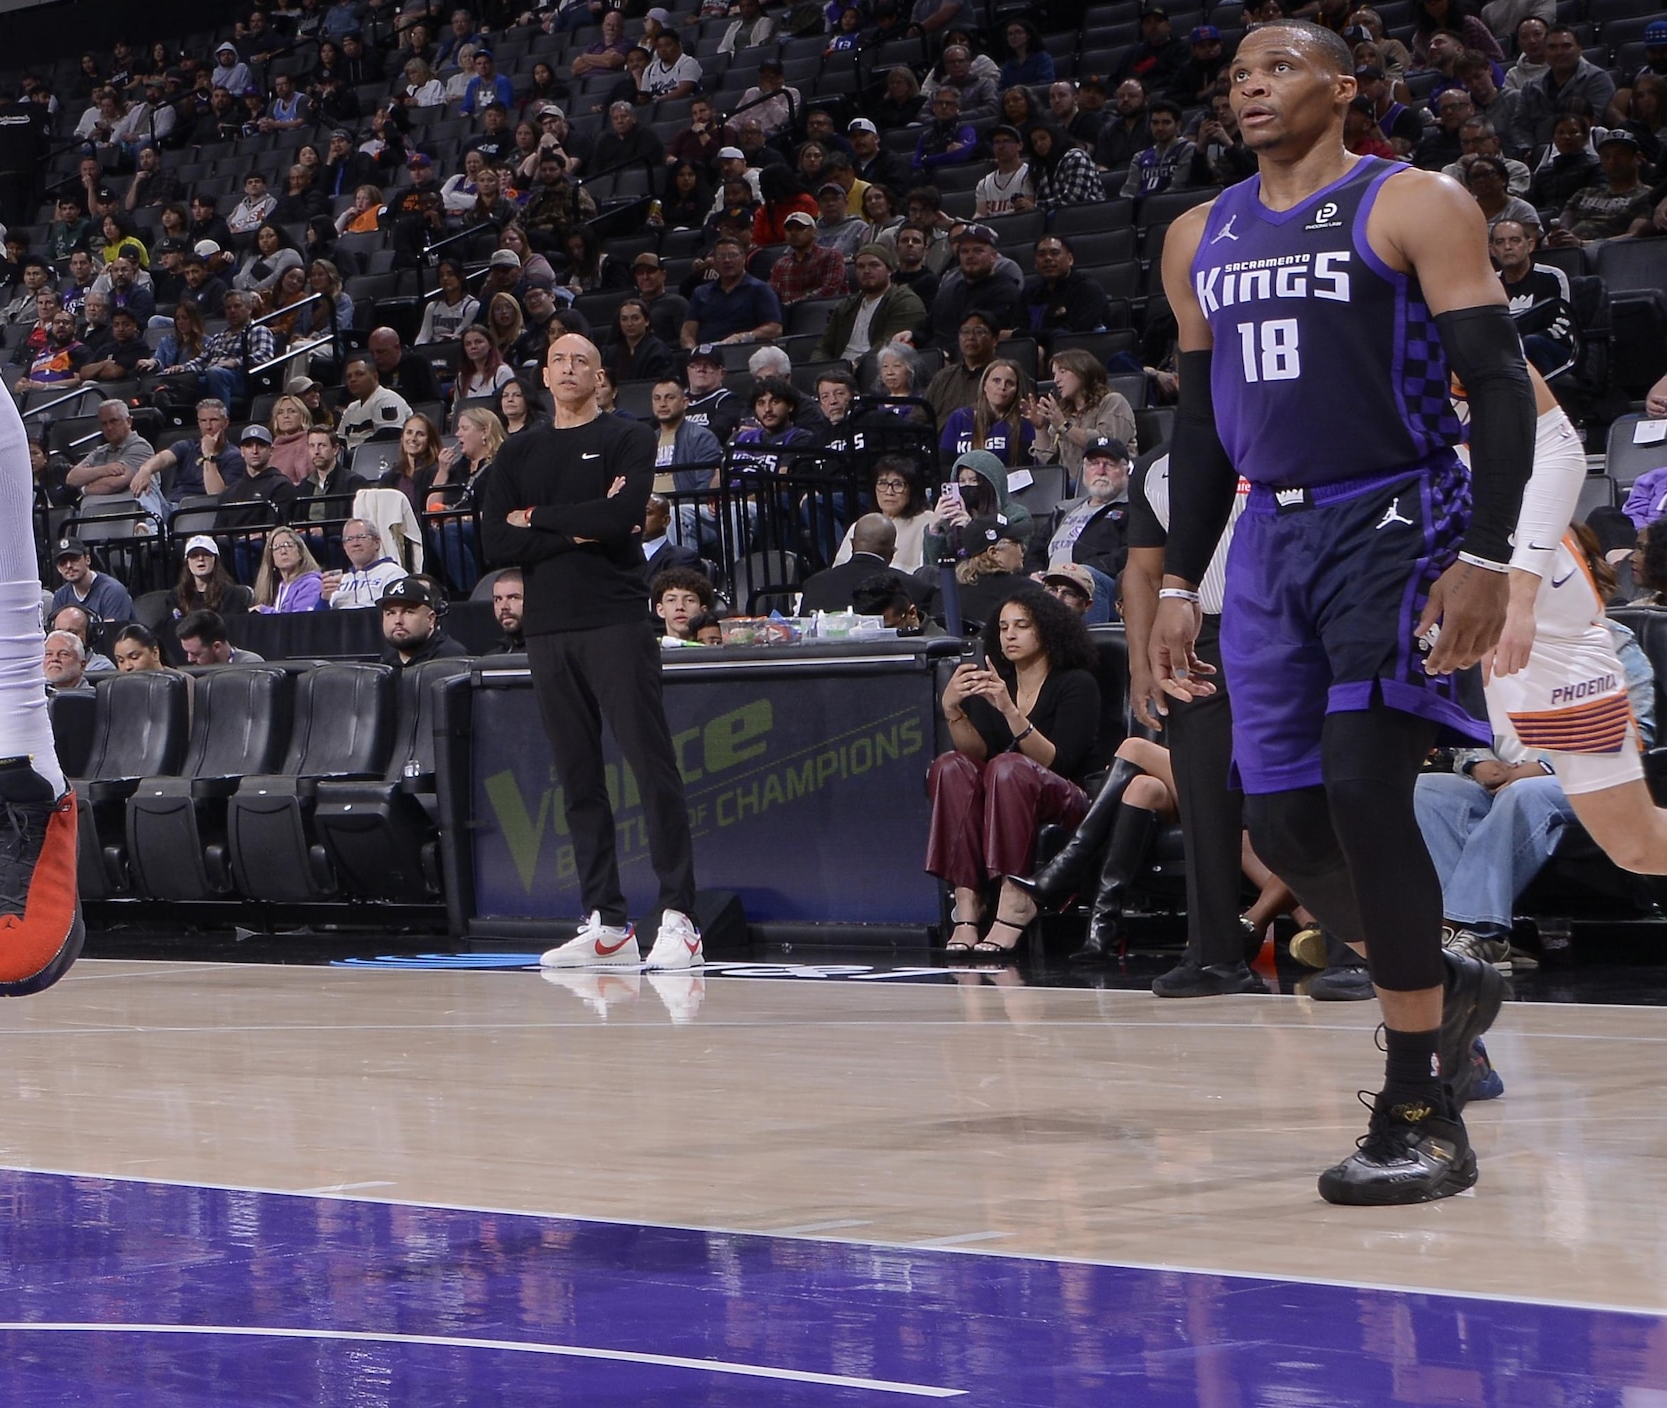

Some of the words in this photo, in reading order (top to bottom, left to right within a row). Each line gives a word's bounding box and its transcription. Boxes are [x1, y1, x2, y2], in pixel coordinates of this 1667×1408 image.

[1196, 251, 1350, 319] KINGS
[1224, 253, 1310, 273] SACRAMENTO
[1237, 318, 1300, 382] 18
[956, 437, 1007, 454] KIGS
[1551, 674, 1617, 704] PHOENIX
[716, 716, 923, 827] CHAMPIONS
